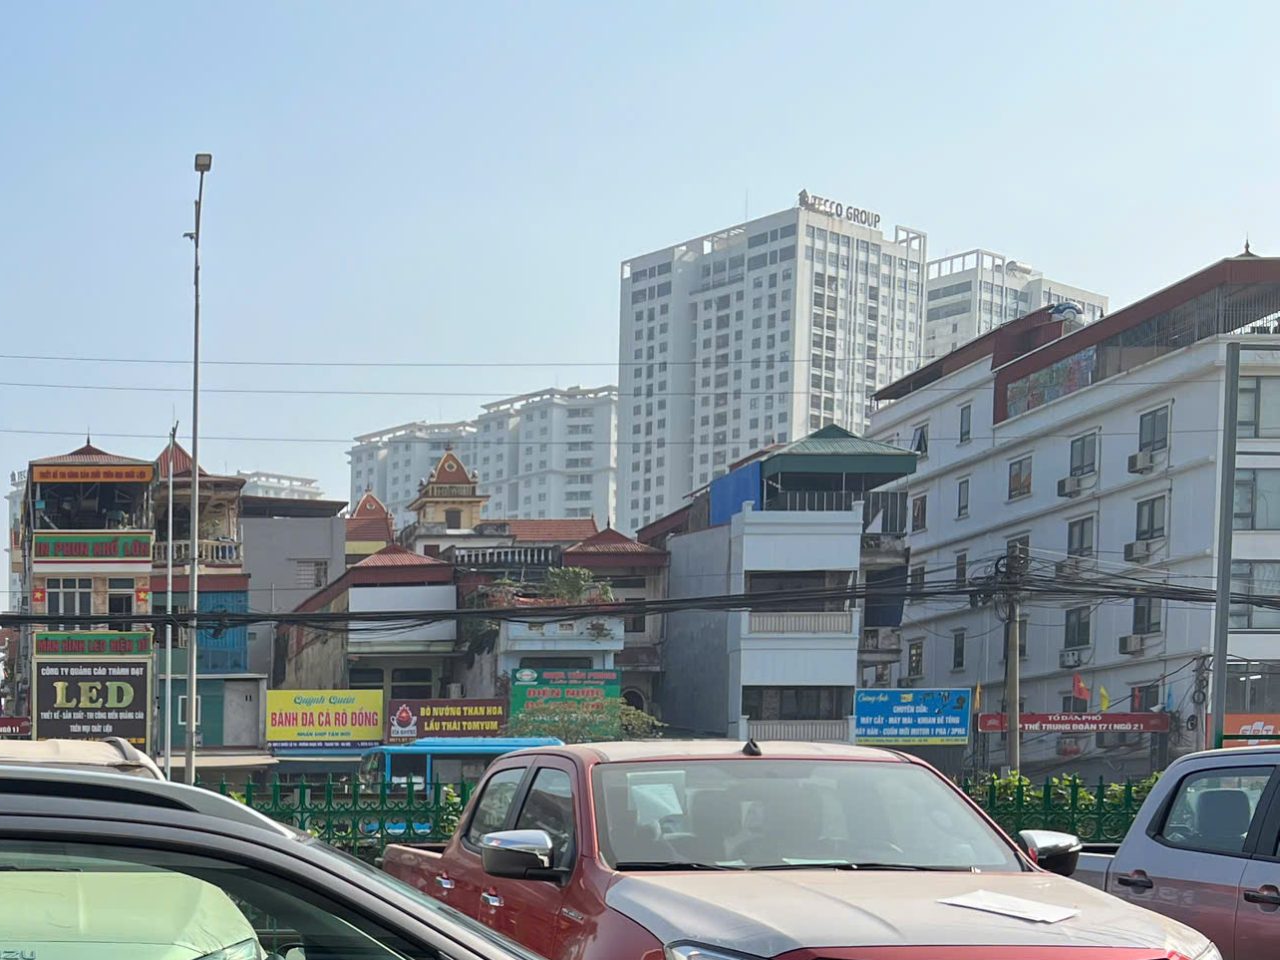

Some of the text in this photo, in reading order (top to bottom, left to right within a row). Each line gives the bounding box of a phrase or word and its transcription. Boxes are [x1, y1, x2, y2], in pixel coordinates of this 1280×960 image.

[846, 205, 881, 229] GROUP
[61, 667, 69, 675] TY
[53, 681, 135, 709] LED
[463, 706, 486, 716] THAN
[486, 705, 503, 716] HOA
[463, 720, 499, 731] TOMYUM
[1042, 723, 1072, 731] TRUNG
